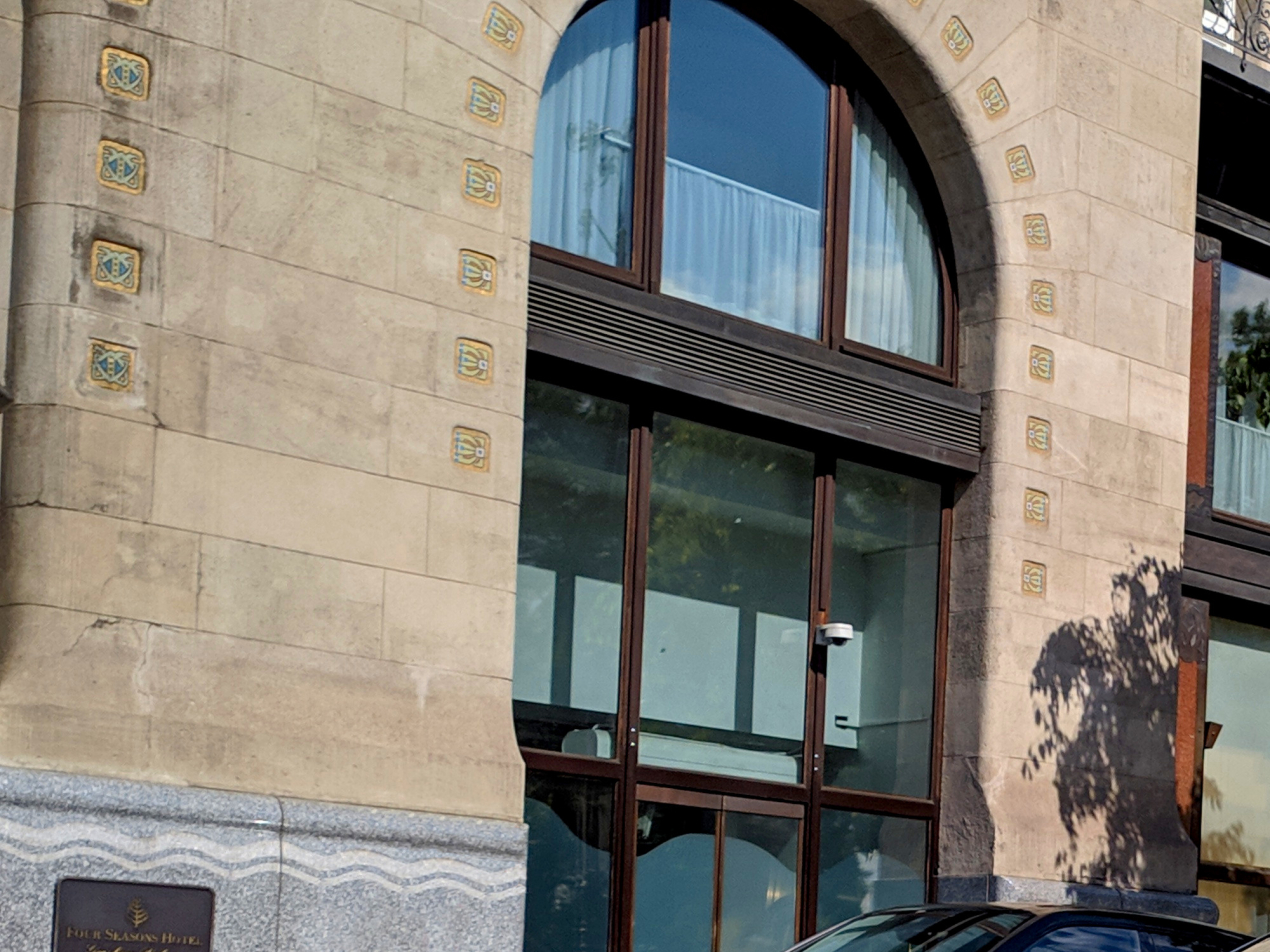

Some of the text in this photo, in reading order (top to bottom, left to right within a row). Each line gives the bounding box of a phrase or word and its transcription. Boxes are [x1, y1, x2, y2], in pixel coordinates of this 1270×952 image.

[67, 926, 203, 945] FOUR SEASONS HOTEL
